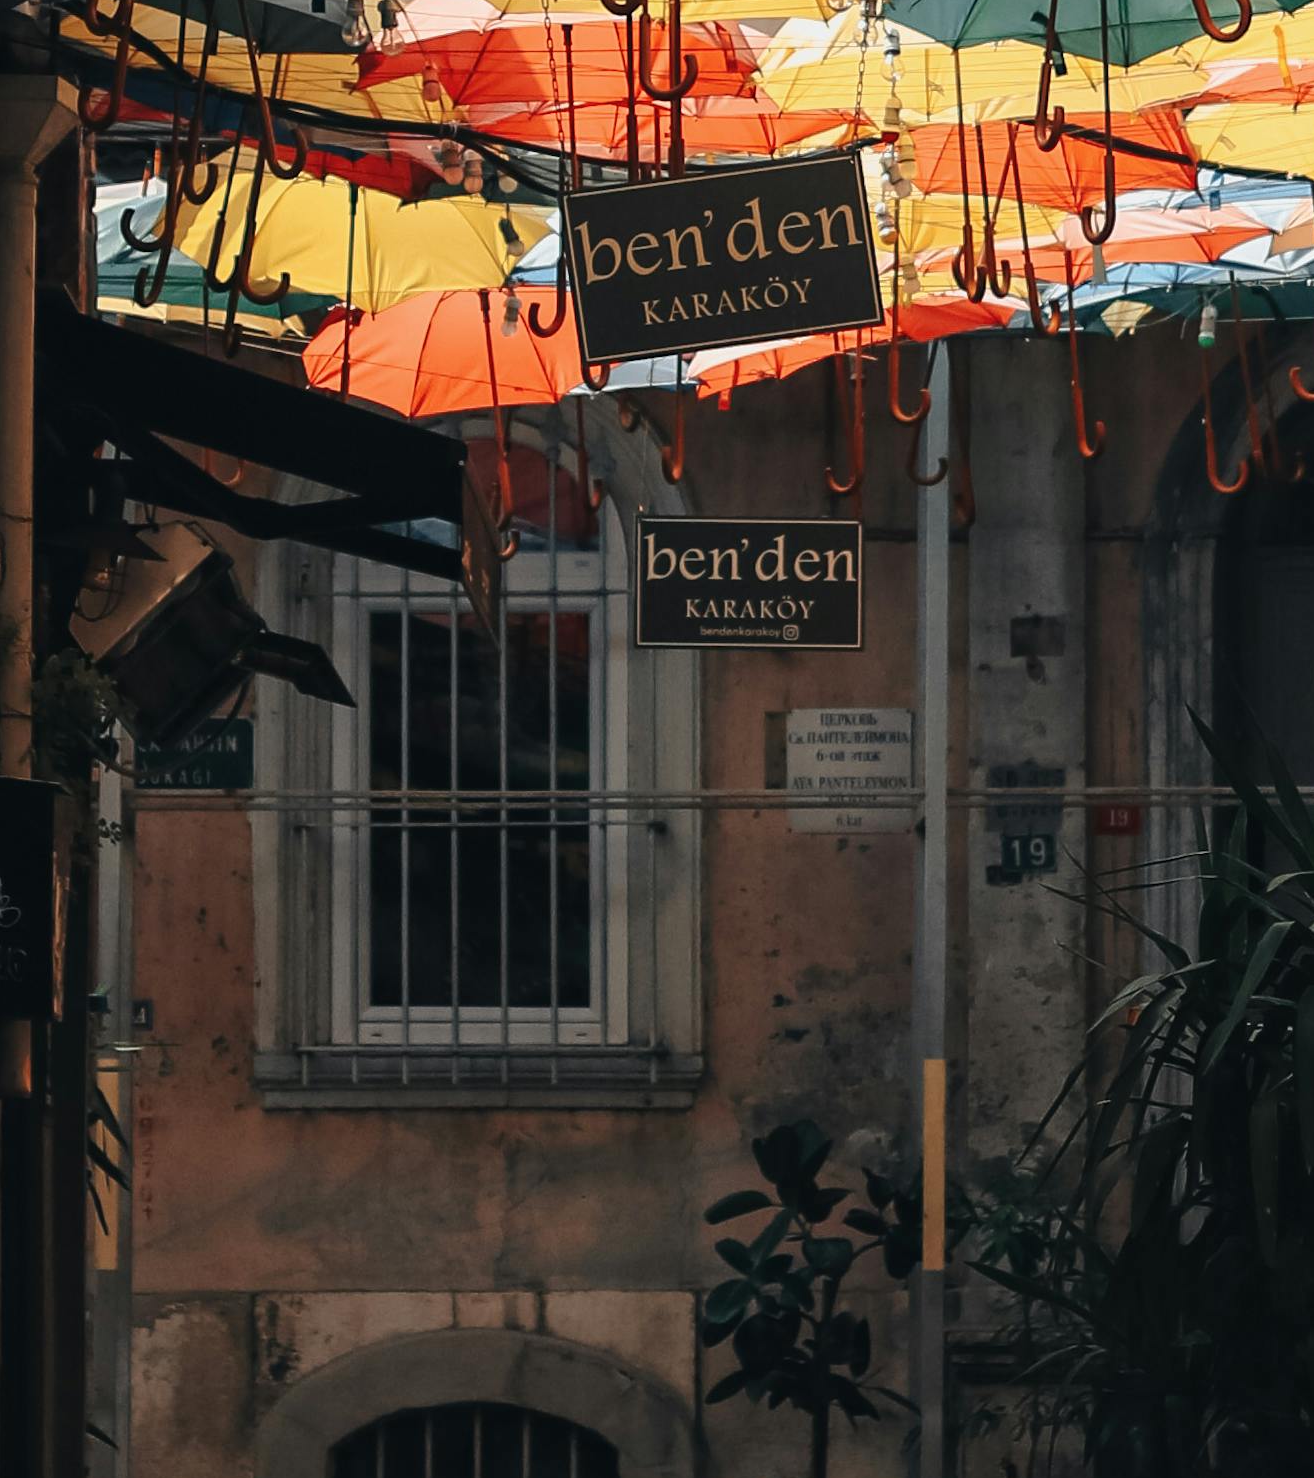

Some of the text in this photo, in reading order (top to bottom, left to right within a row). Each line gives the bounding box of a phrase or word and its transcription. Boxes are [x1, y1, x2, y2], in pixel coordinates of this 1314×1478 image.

[574, 196, 863, 286] ben'den
[642, 276, 813, 326] KARAKÖY
[643, 533, 857, 582] ben'den
[685, 595, 815, 620] KARAKÖY
[700, 625, 782, 639] bendenkarakoy
[1110, 808, 1129, 827] 19
[1011, 838, 1046, 867] 19
